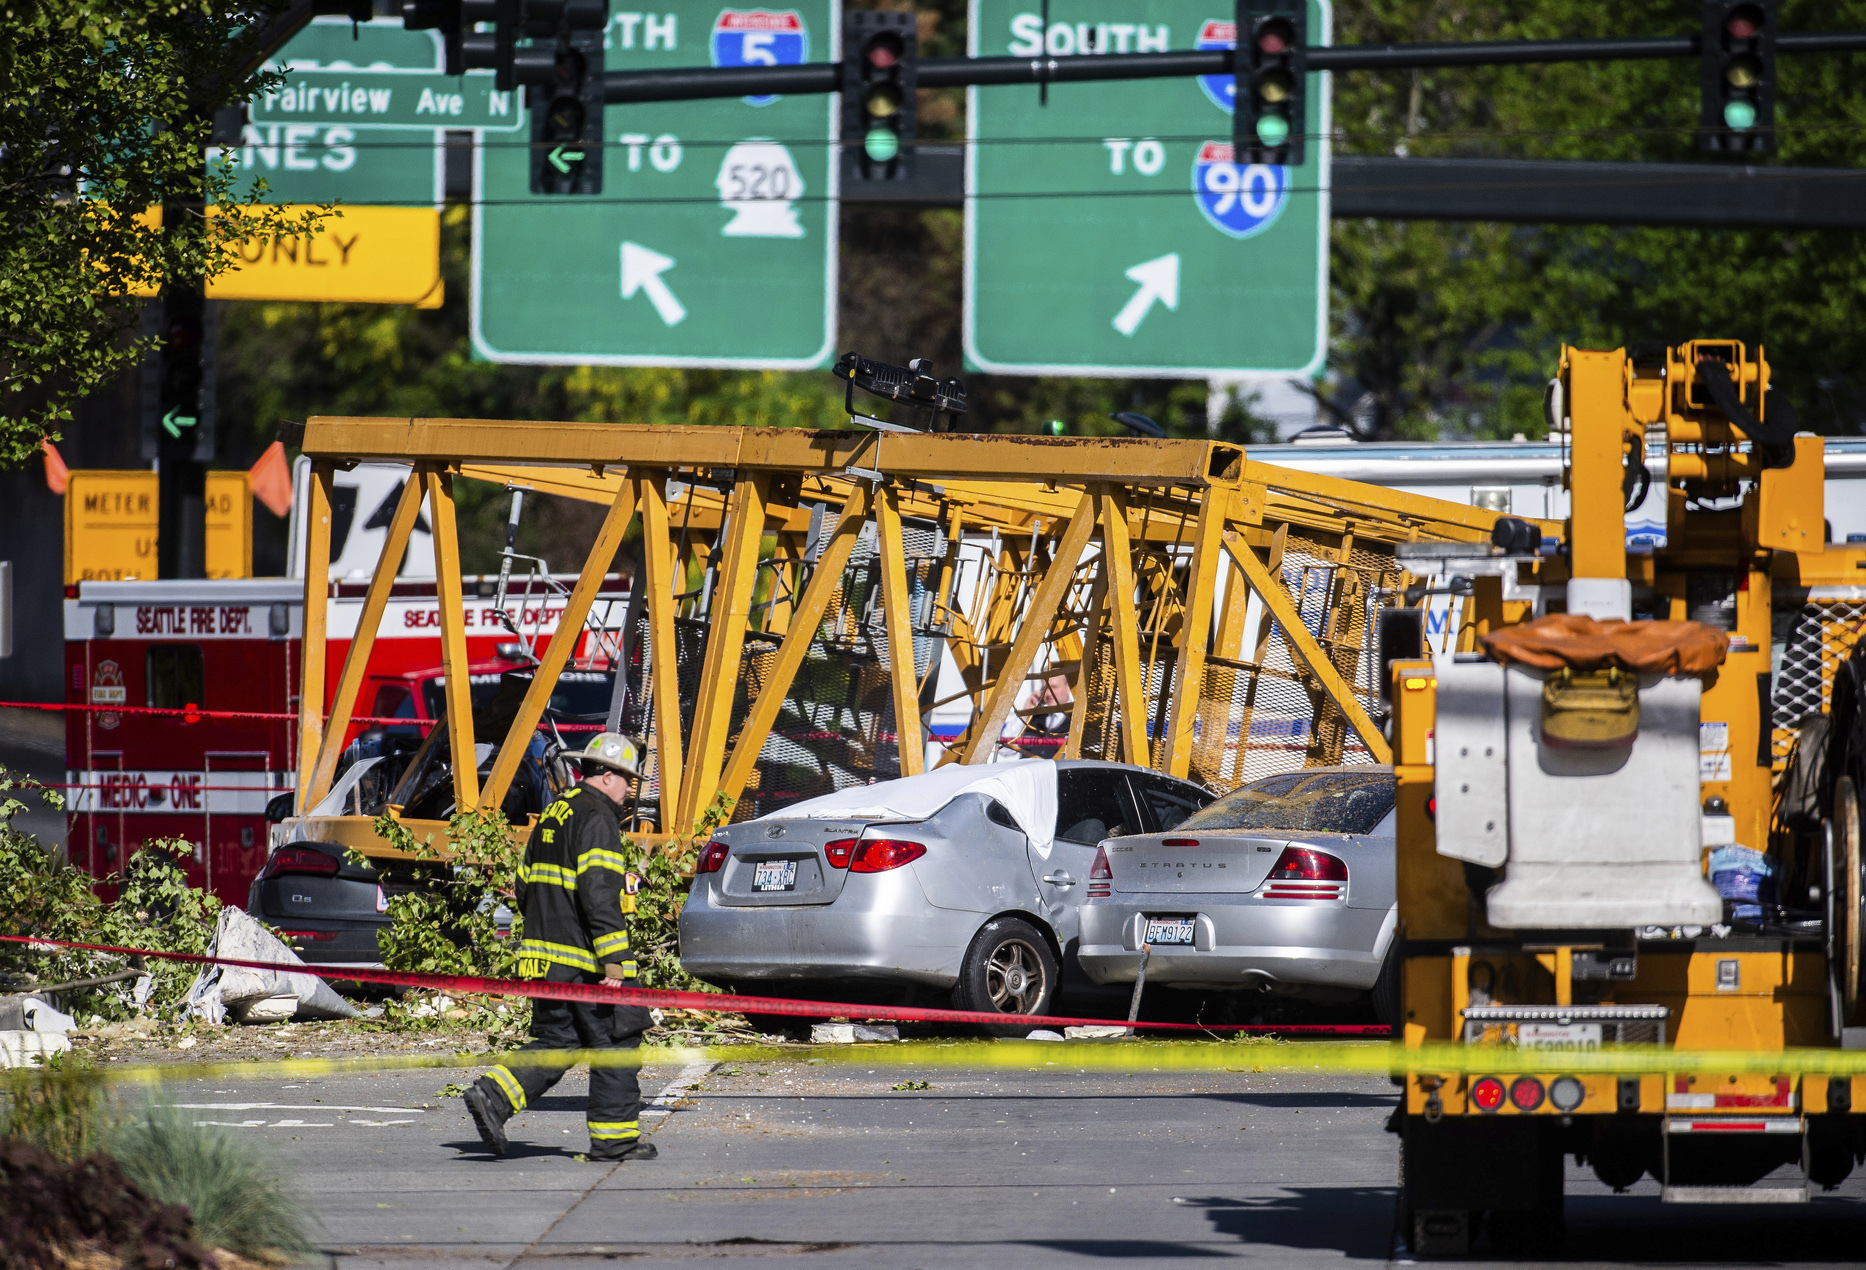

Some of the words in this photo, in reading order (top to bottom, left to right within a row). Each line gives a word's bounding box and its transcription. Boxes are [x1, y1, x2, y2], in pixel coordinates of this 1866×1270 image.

[742, 33, 778, 67] 5
[1008, 13, 1170, 56] SOUTH
[264, 81, 393, 113] Fairview
[416, 87, 464, 115] Ave
[488, 90, 510, 116] N
[206, 124, 357, 171] NES
[619, 134, 683, 173] TO
[1103, 137, 1166, 175] TO
[730, 165, 790, 200] 520
[1204, 163, 1277, 218] 90
[238, 232, 361, 266] ONLY
[84, 492, 151, 515] METER
[206, 493, 232, 514] AD
[137, 607, 186, 634] SEATTLE
[190, 607, 216, 634] FIRE
[220, 607, 253, 634] DEPT.
[101, 773, 147, 809] MEDIC
[171, 774, 202, 809] ONE
[539, 800, 574, 826] SEATTLE
[823, 827, 860, 835] ELANTRA
[1148, 925, 1193, 941] BFM9122
